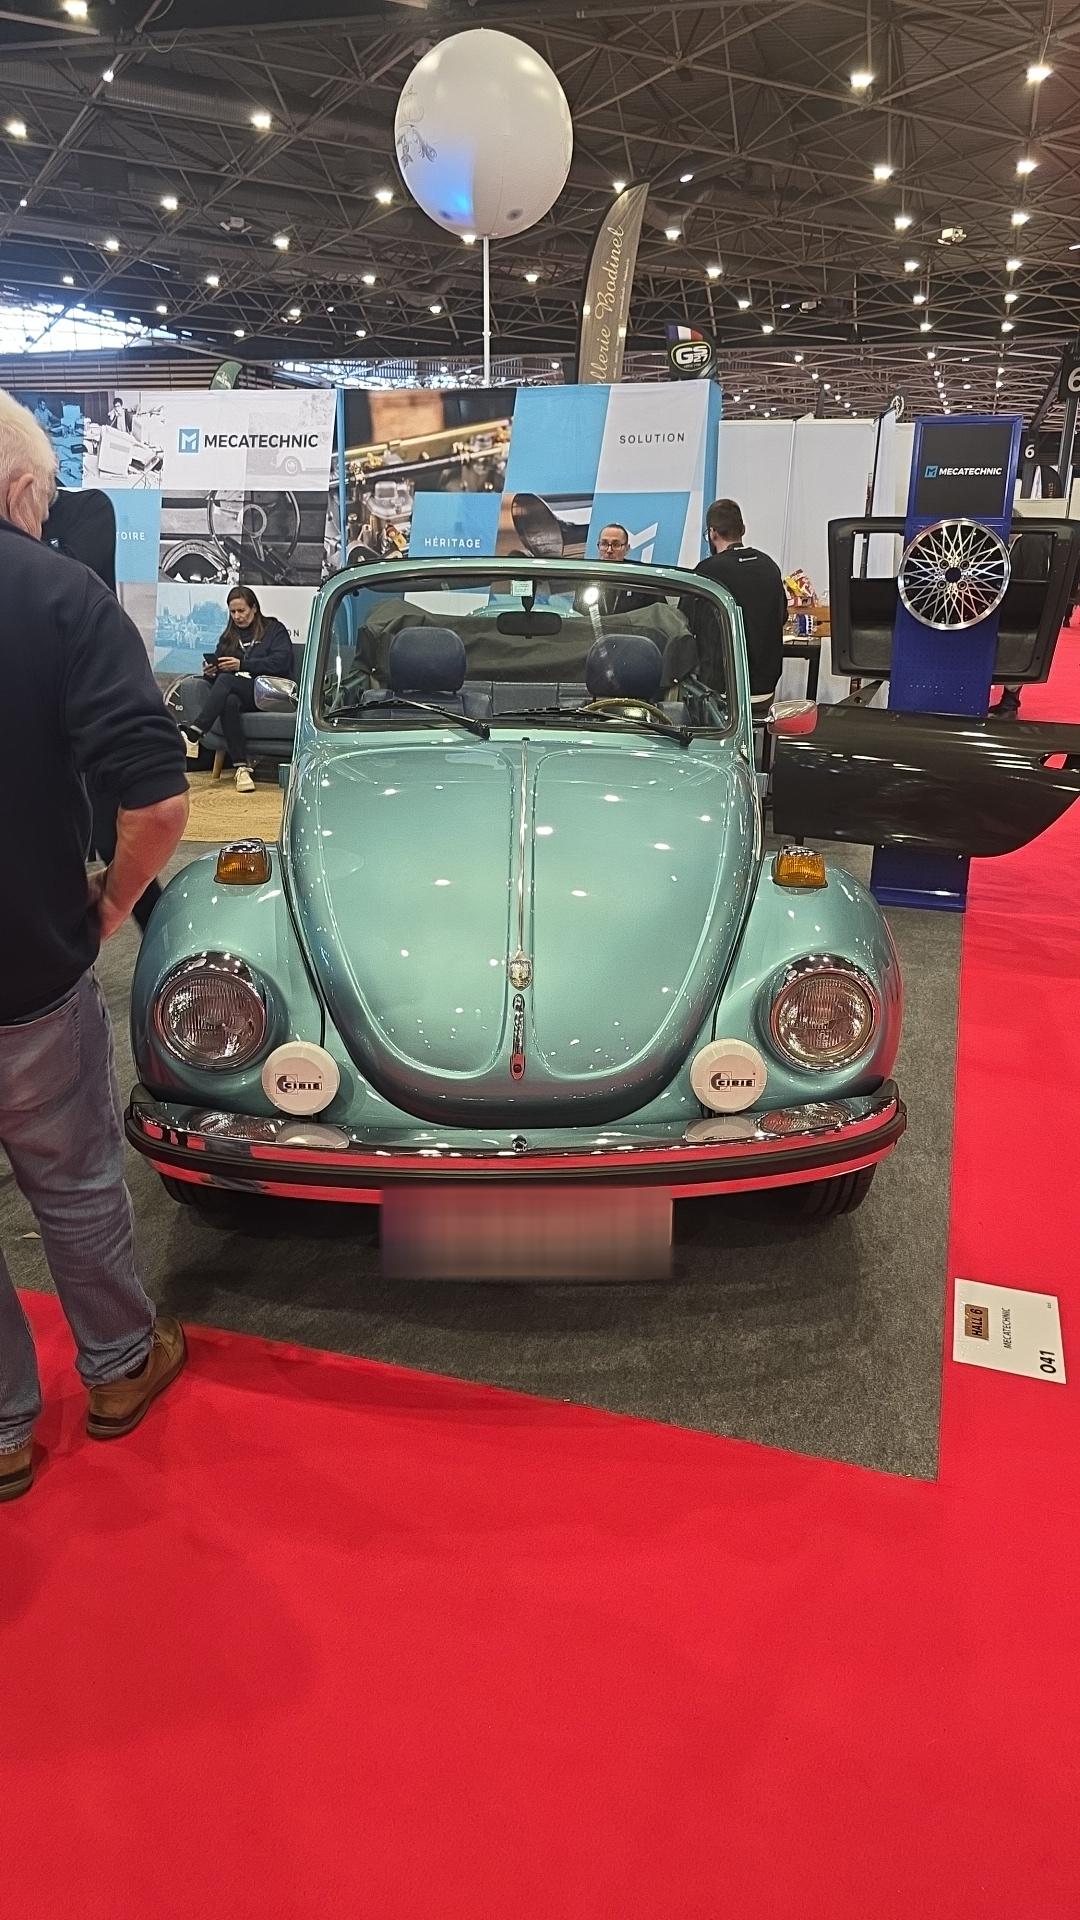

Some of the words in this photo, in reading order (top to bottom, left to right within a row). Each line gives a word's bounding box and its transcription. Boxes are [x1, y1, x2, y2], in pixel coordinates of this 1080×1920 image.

[590, 325, 611, 384] llerie
[204, 434, 319, 448] MECATECHNIC
[619, 432, 685, 444] SOLUTION
[1024, 443, 1035, 459] 6
[938, 467, 1002, 476] MECATECHNIC
[424, 535, 481, 549] HÉRITAGE
[970, 1307, 983, 1315] 6
[971, 1316, 983, 1337] HALL
[1002, 1307, 1012, 1349] MECATECHNIC
[1039, 1350, 1057, 1374] 041
